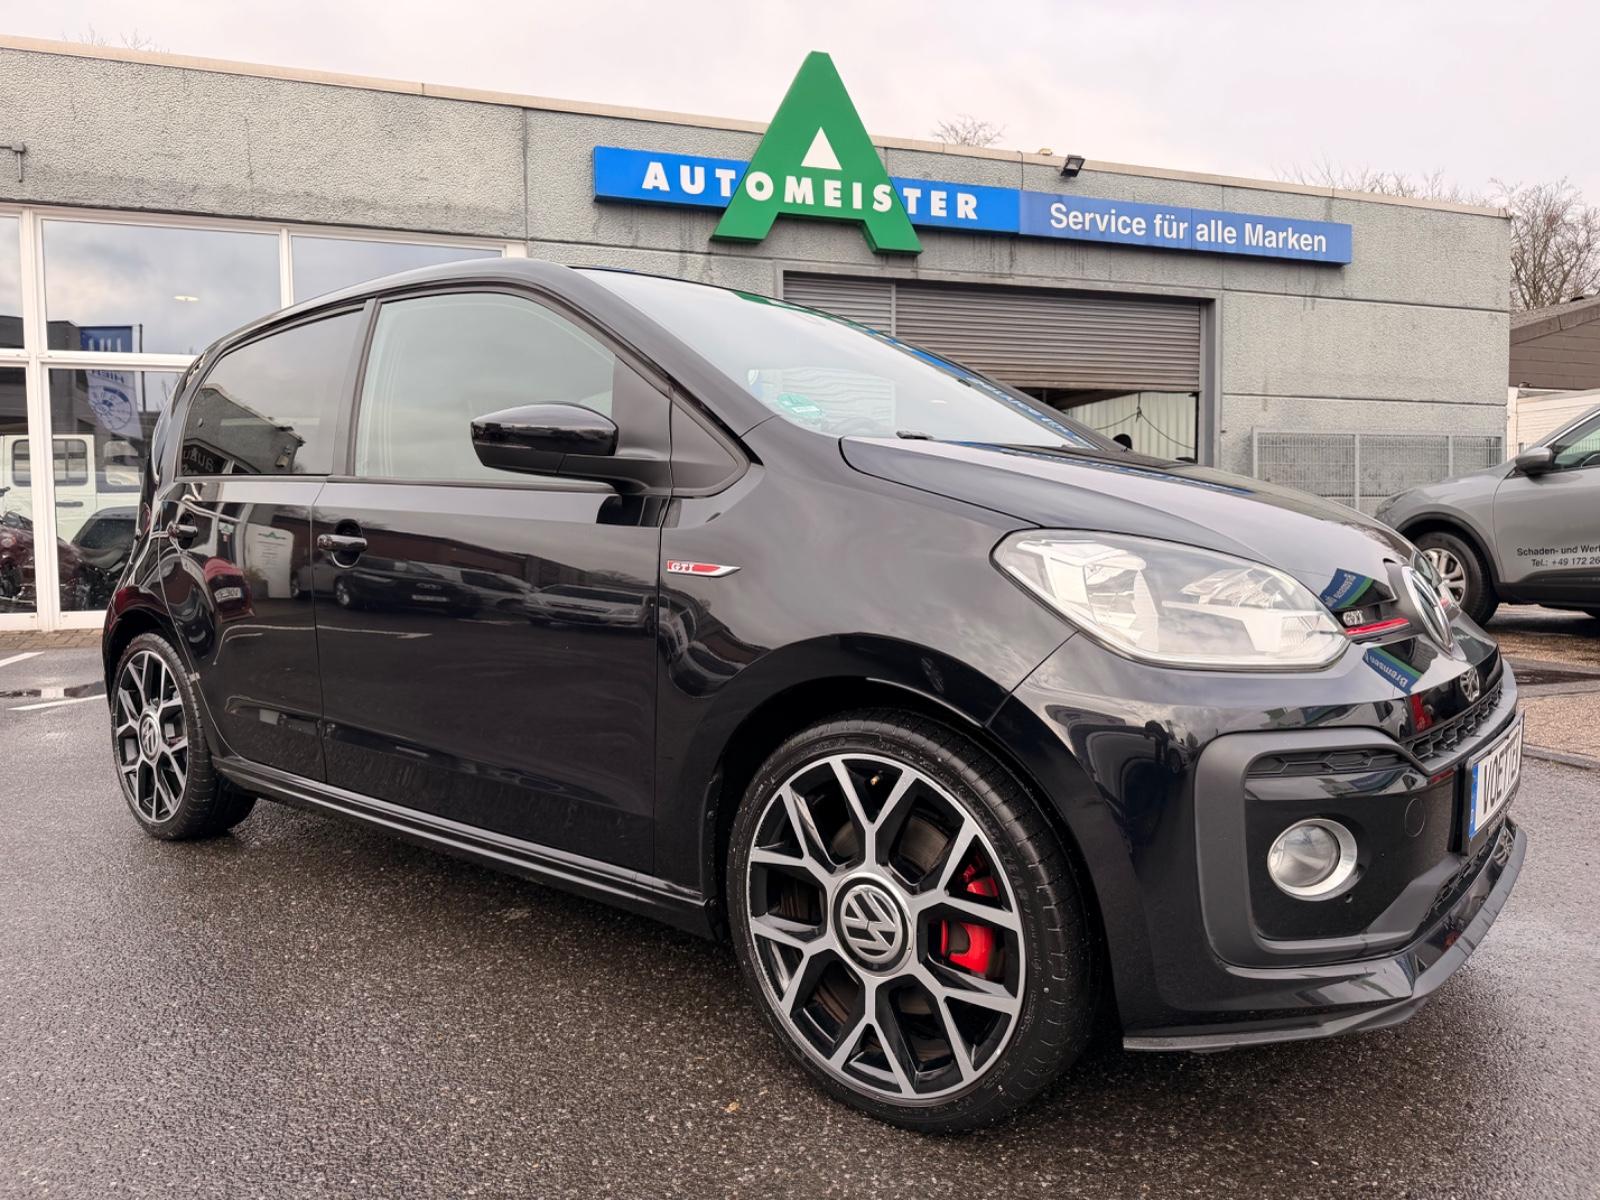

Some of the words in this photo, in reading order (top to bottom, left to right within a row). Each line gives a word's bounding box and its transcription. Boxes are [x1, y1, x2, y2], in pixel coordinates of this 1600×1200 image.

[641, 161, 978, 222] AUTOMEISTER
[1049, 202, 1147, 237] Service
[1153, 213, 1189, 241] für
[1195, 218, 1238, 245] alle
[1244, 222, 1328, 253] Marken
[1516, 546, 1559, 557] Schaden-
[1561, 545, 1579, 555] und
[671, 561, 695, 573] GTI
[1552, 557, 1569, 566] +49
[1572, 556, 1587, 566] 172
[1342, 609, 1364, 627] GTI
